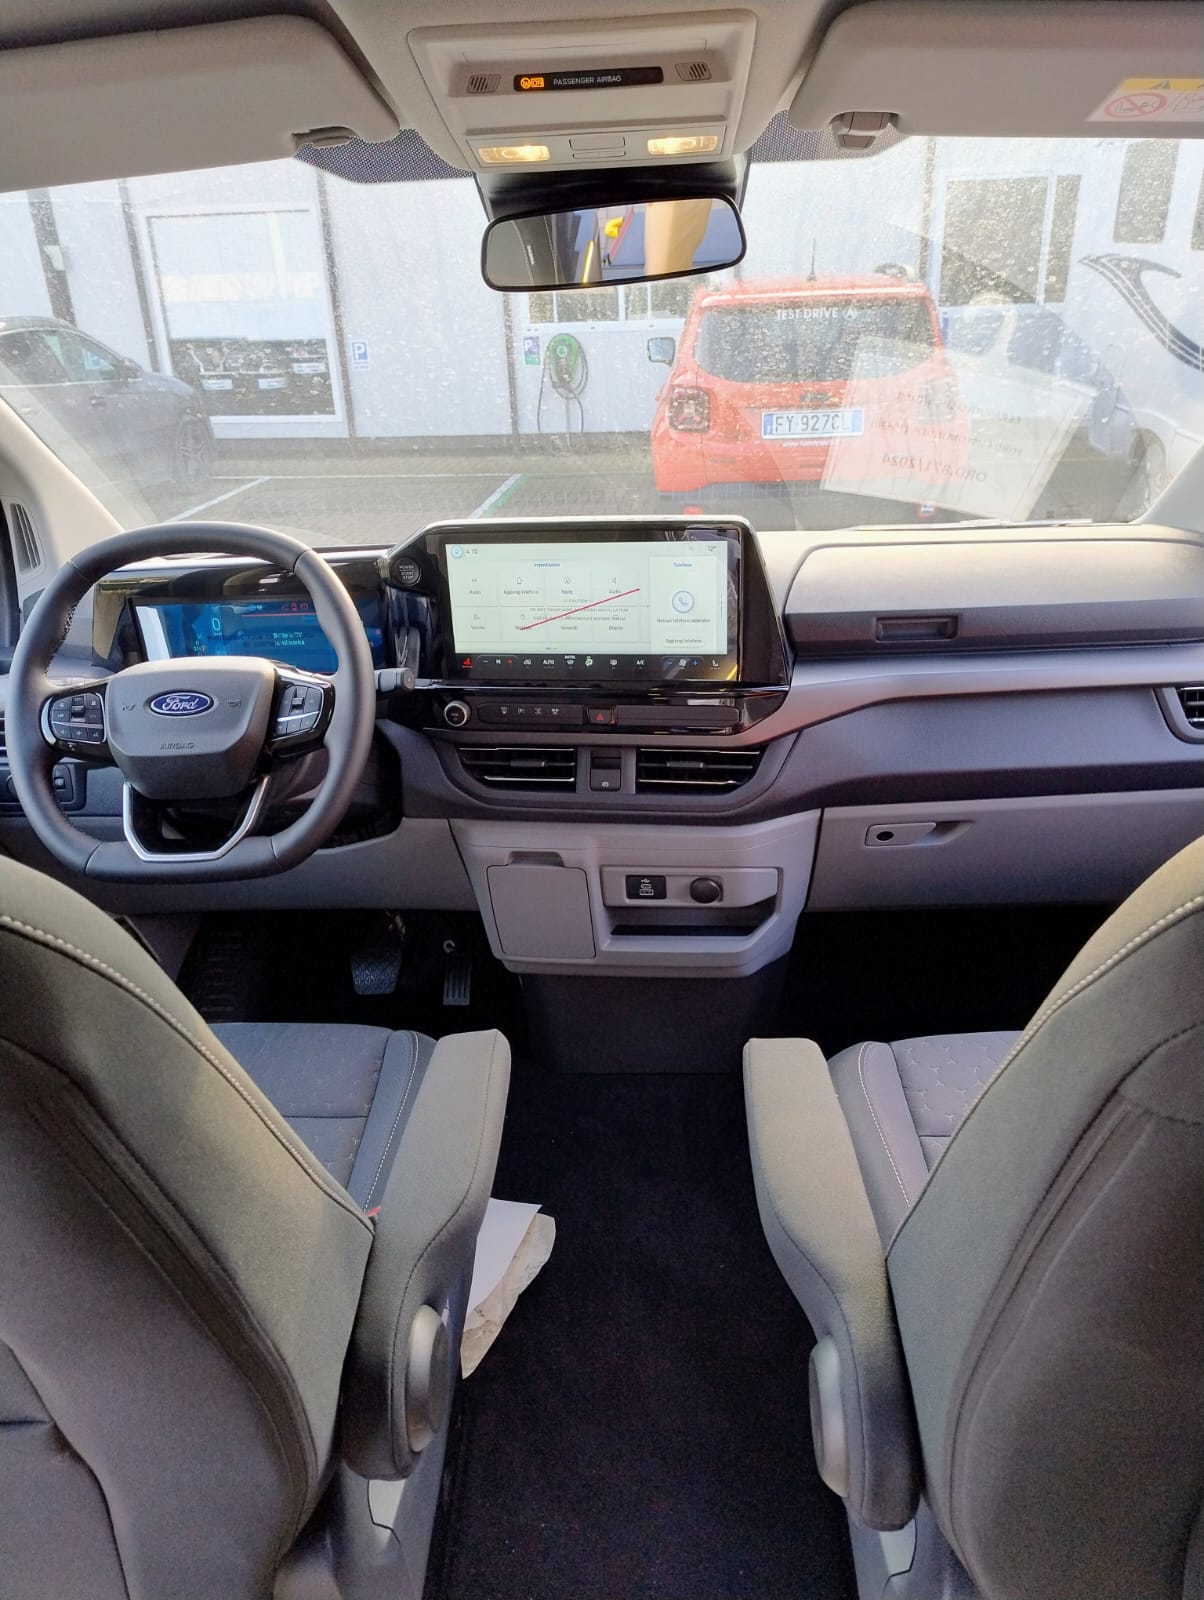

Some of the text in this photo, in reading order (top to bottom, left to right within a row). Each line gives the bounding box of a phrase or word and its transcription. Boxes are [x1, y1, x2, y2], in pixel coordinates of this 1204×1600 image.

[553, 77, 594, 86] PASSENGER
[596, 75, 622, 84] AIRBAG
[777, 309, 799, 320] TEST
[803, 307, 839, 320] DRIVE
[354, 345, 365, 360] P
[775, 415, 794, 433] FY
[211, 617, 221, 631] 0
[161, 695, 198, 712] Ford
